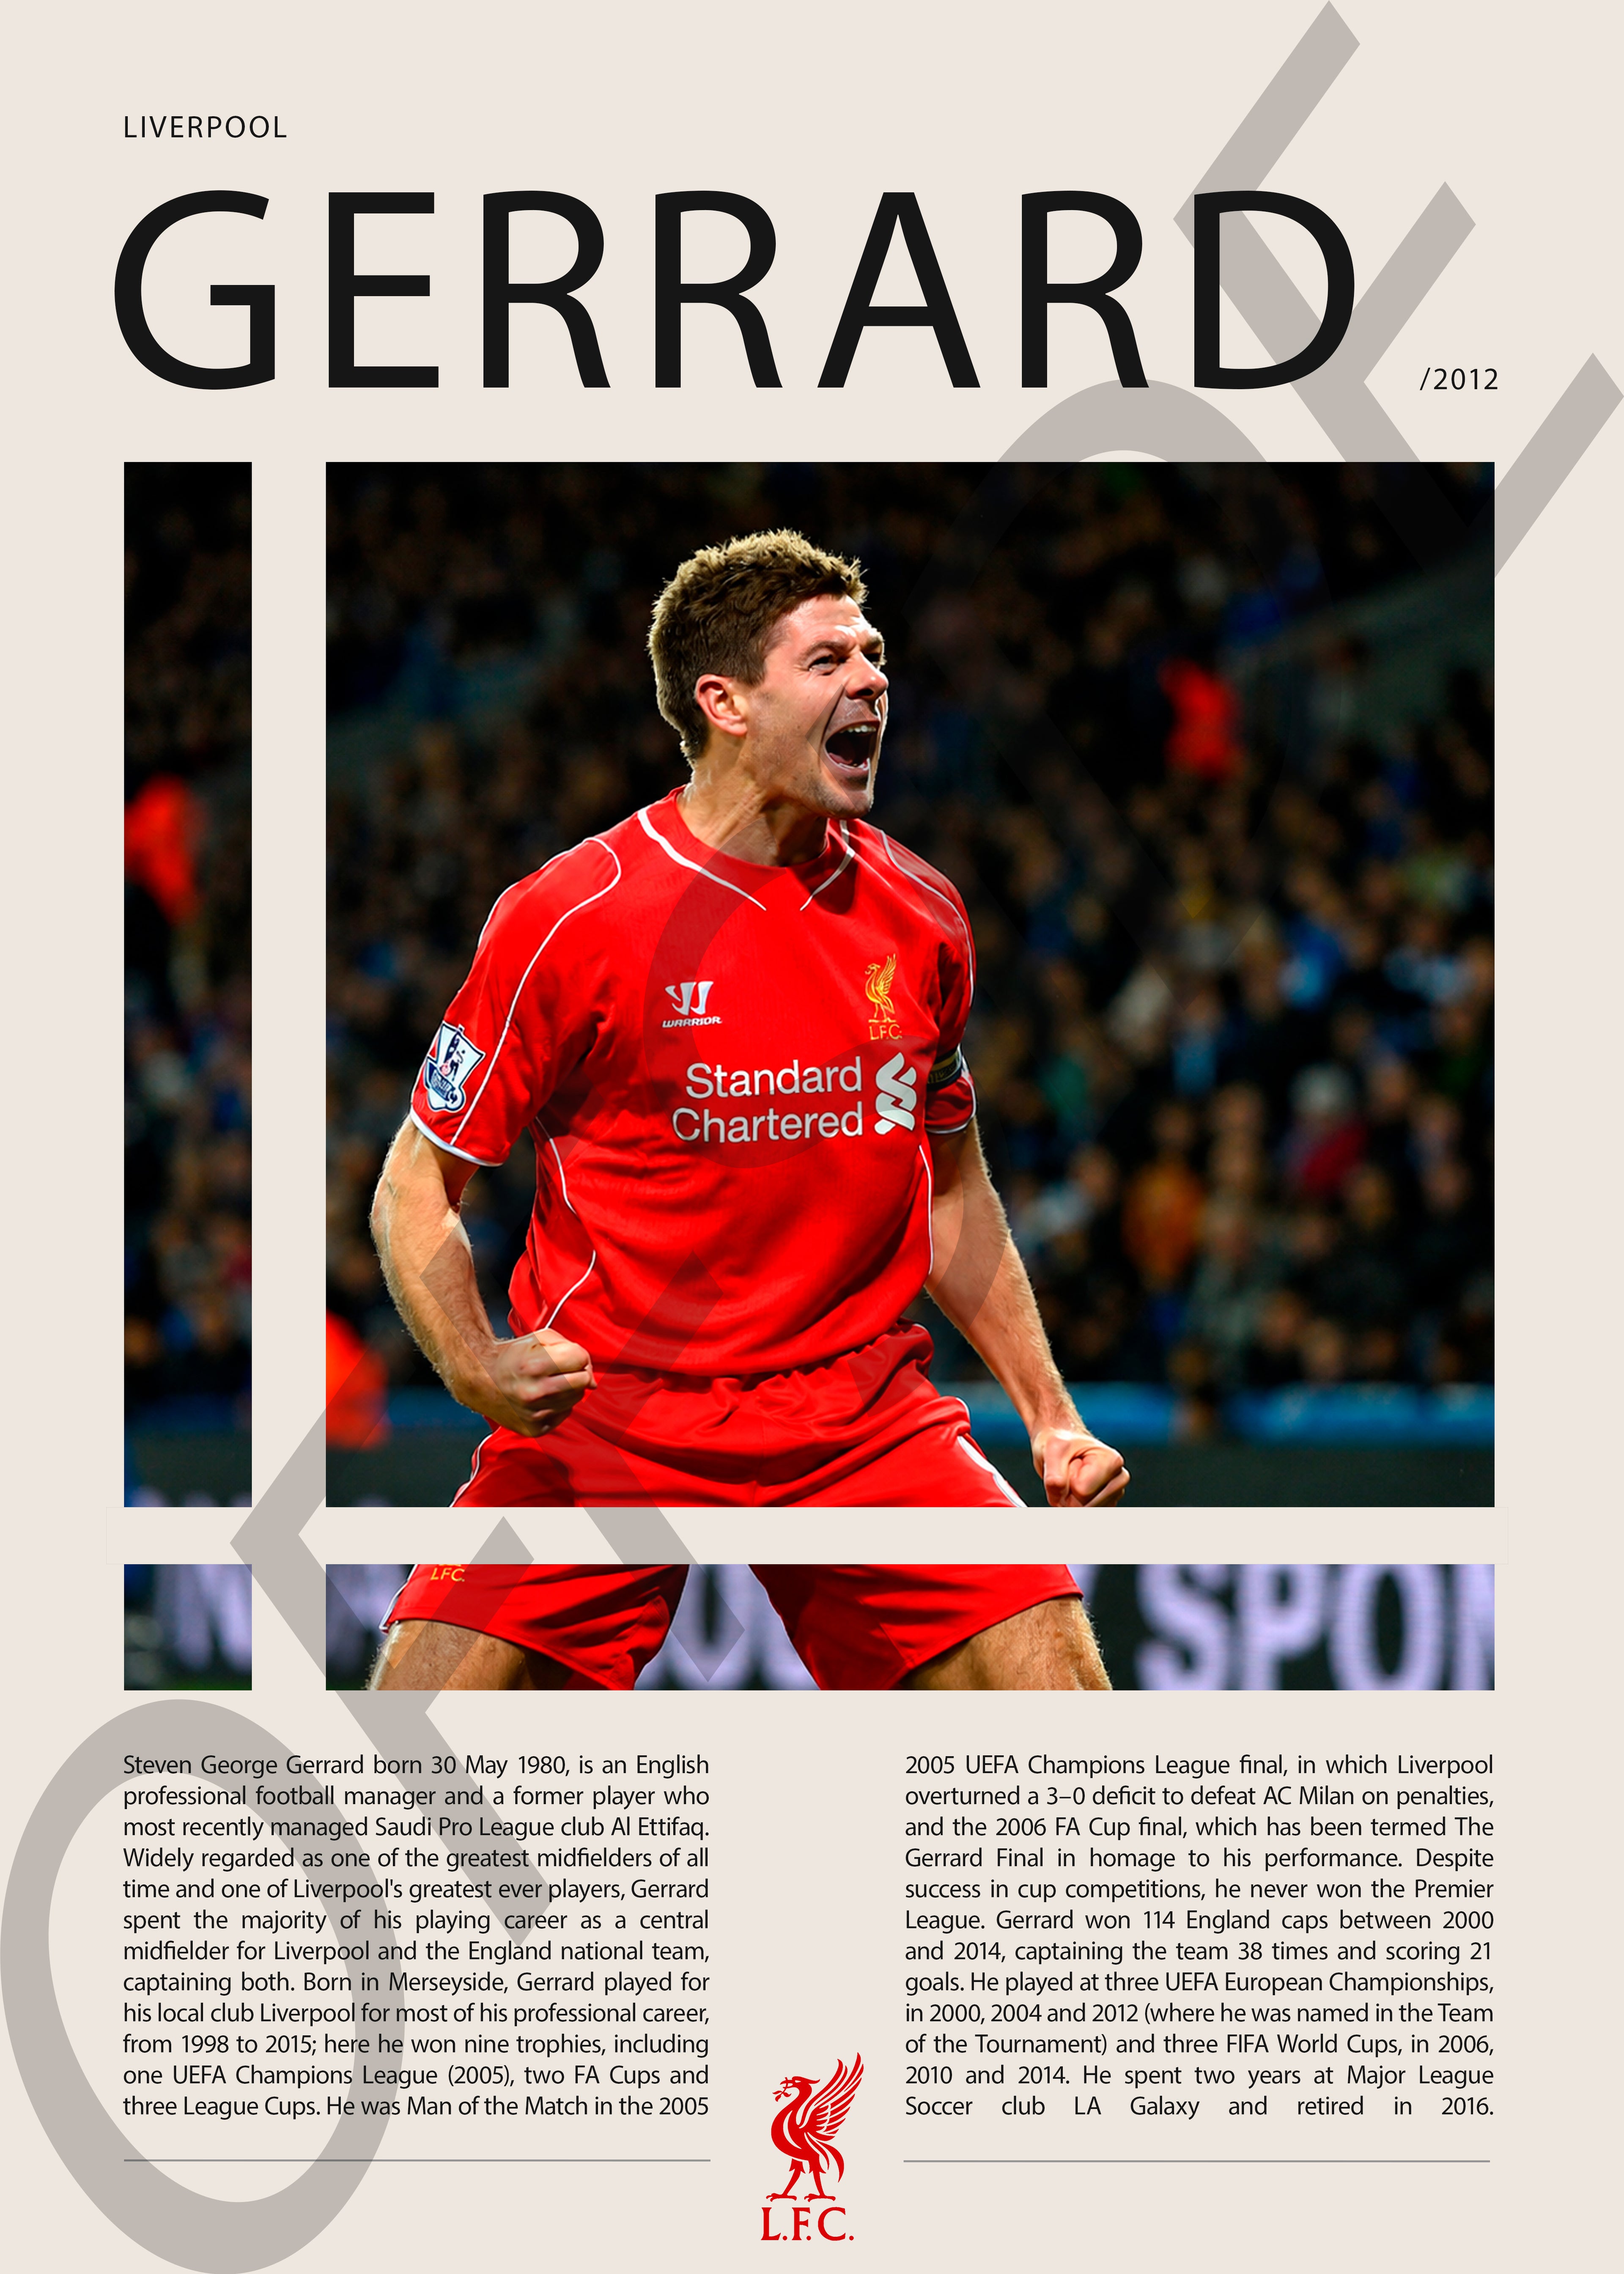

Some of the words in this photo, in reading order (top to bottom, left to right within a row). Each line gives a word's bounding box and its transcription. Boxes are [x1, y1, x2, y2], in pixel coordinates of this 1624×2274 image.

[125, 115, 287, 138] LIVERPOOL
[114, 190, 1355, 390] GERRARD
[1420, 367, 1498, 390] /2012
[662, 1016, 722, 1028] WARRIOR
[685, 1056, 862, 1099] Standard
[672, 1101, 863, 1143] Chartered
[123, 1755, 191, 1774] Steven
[201, 1755, 277, 1779] George
[286, 1754, 363, 1774] Gerrard
[374, 1754, 422, 1774] born
[431, 1756, 456, 1774] 30
[466, 1755, 508, 1779] May
[518, 1756, 570, 1777] 1980,
[579, 1755, 593, 1774] is
[602, 1760, 626, 1774] an
[637, 1754, 708, 1779] English
[906, 1756, 955, 1774] 2005
[966, 1755, 1019, 1774] UEFA
[1028, 1754, 1145, 1779] Champions
[1156, 1755, 1230, 1779] League
[1239, 1754, 1288, 1777] final,
[1298, 1755, 1315, 1774] in
[1325, 1754, 1387, 1774] which
[1399, 1754, 1492, 1779] Liverpool
[124, 1785, 246, 1810] professional
[255, 1785, 334, 1805] football
[345, 1791, 436, 1810] manager
[444, 1785, 483, 1805] and
[493, 1791, 504, 1805] a
[513, 1785, 584, 1805] former
[593, 1785, 655, 1810] player
[664, 1785, 709, 1805] who
[124, 1818, 175, 1836] most
[183, 1816, 264, 1841] recently
[271, 1816, 368, 1841] managed
[376, 1816, 431, 1836] Saudi
[439, 1817, 472, 1836] Pro
[480, 1817, 554, 1841] League
[561, 1816, 604, 1836] club
[611, 1816, 630, 1836] Al
[639, 1816, 709, 1840] Ettifaq.
[905, 1847, 982, 1867] Gerrard
[997, 1847, 1043, 1867] Final
[1058, 1848, 1075, 1867] in
[1090, 1847, 1175, 1872] homage
[1188, 1850, 1210, 1867] to
[1224, 1847, 1251, 1867] his
[1265, 1847, 1402, 1872] performance.
[1417, 1848, 1494, 1872] Despite
[123, 1879, 170, 1898] time
[176, 1878, 214, 1898] and
[222, 1884, 261, 1898] one
[267, 1878, 289, 1898] of
[294, 1878, 403, 1903] Liverpool's
[409, 1881, 492, 1903] greatest
[499, 1884, 542, 1898] ever
[549, 1878, 625, 1903] players,
[631, 1878, 708, 1898] Gerrard
[905, 1884, 981, 1898] success
[991, 1879, 1008, 1898] in
[1018, 1884, 1056, 1903] cup
[1066, 1879, 1205, 1903] competitions,
[1216, 1878, 1240, 1898] he
[1251, 1884, 1308, 1898] never
[1317, 1884, 1361, 1898] won
[1371, 1878, 1405, 1898] the
[1416, 1879, 1494, 1898] Premier
[906, 1910, 985, 1934] League.
[996, 1909, 1073, 1929] Gerrard
[1085, 1915, 1130, 1929] won
[1144, 1911, 1175, 1929] 114
[1187, 1909, 1269, 1934] England
[1282, 1915, 1328, 1933] caps
[1340, 1909, 1431, 1929] between
[1443, 1911, 1494, 1929] 2000
[124, 1940, 229, 1960] midfielder
[236, 1940, 266, 1960] for
[275, 1940, 369, 1965] Liverpool
[378, 1940, 416, 1960] and
[425, 1940, 459, 1960] the
[469, 1940, 551, 1965] England
[561, 1940, 643, 1960] national
[652, 1943, 709, 1963] team,
[905, 1940, 943, 1960] and
[954, 1942, 1006, 1963] 2014,
[1015, 1941, 1122, 1965] captaining
[1132, 1940, 1166, 1960] the
[1176, 1943, 1228, 1960] team
[1238, 1942, 1262, 1960] 38
[1272, 1941, 1328, 1960] times
[1337, 1940, 1376, 1960] and
[1386, 1941, 1459, 1965] scoring
[123, 1972, 231, 1996] captaining
[241, 1971, 294, 1991] both.
[304, 1972, 351, 1991] Born
[362, 1972, 379, 1991] in
[389, 1971, 508, 1996] Merseyside,
[517, 1971, 594, 1991] Gerrard
[605, 1971, 672, 1996] played
[680, 1971, 710, 1991] for
[905, 1971, 964, 1996] goals.
[971, 1972, 999, 1991] He
[1006, 1971, 1073, 1996] played
[1080, 1974, 1099, 1991] at
[1105, 1971, 1159, 1991] three
[1166, 1972, 1218, 1991] UEFA
[1226, 1972, 1322, 1996] European
[1329, 1971, 1494, 1996] Championships,
[123, 2033, 172, 2053] from
[182, 2035, 229, 2053] 1998
[236, 2035, 258, 2053] to
[266, 2035, 316, 2056] 2015;
[325, 2033, 370, 2053] here
[379, 2033, 403, 2053] he
[411, 2039, 455, 2053] won
[465, 2034, 509, 2053] nine
[516, 2033, 606, 2058] trophies,
[614, 2033, 708, 2058] including
[123, 2070, 162, 2084] one
[173, 2065, 226, 2084] UEFA
[236, 2064, 352, 2089] Champions
[363, 2065, 438, 2089] League
[448, 2065, 514, 2087] (2005),
[524, 2067, 565, 2084] two
[575, 2065, 600, 2084] FA
[610, 2065, 660, 2089] Cups
[670, 2064, 708, 2084] and
[905, 2066, 952, 2084] 2010
[966, 2064, 1004, 2084] and
[1018, 2066, 1070, 2084] 2014.
[1084, 2065, 1111, 2084] He
[1125, 2067, 1182, 2089] spent
[1194, 2067, 1235, 2084] two
[1248, 2070, 1300, 2089] years
[1314, 2067, 1333, 2084] at
[1347, 2065, 1406, 2089] Major
[1420, 2065, 1494, 2089] League
[905, 2096, 973, 2115] Soccer
[1002, 2095, 1045, 2115] club
[1075, 2096, 1101, 2115] LA
[1130, 2095, 1200, 2120] Galaxy
[1229, 2095, 1267, 2115] and
[1298, 2095, 1363, 2115] retired
[1394, 2096, 1412, 2115] in
[1442, 2097, 1493, 2115] 2016.
[760, 2207, 854, 2241] L.F.C.
